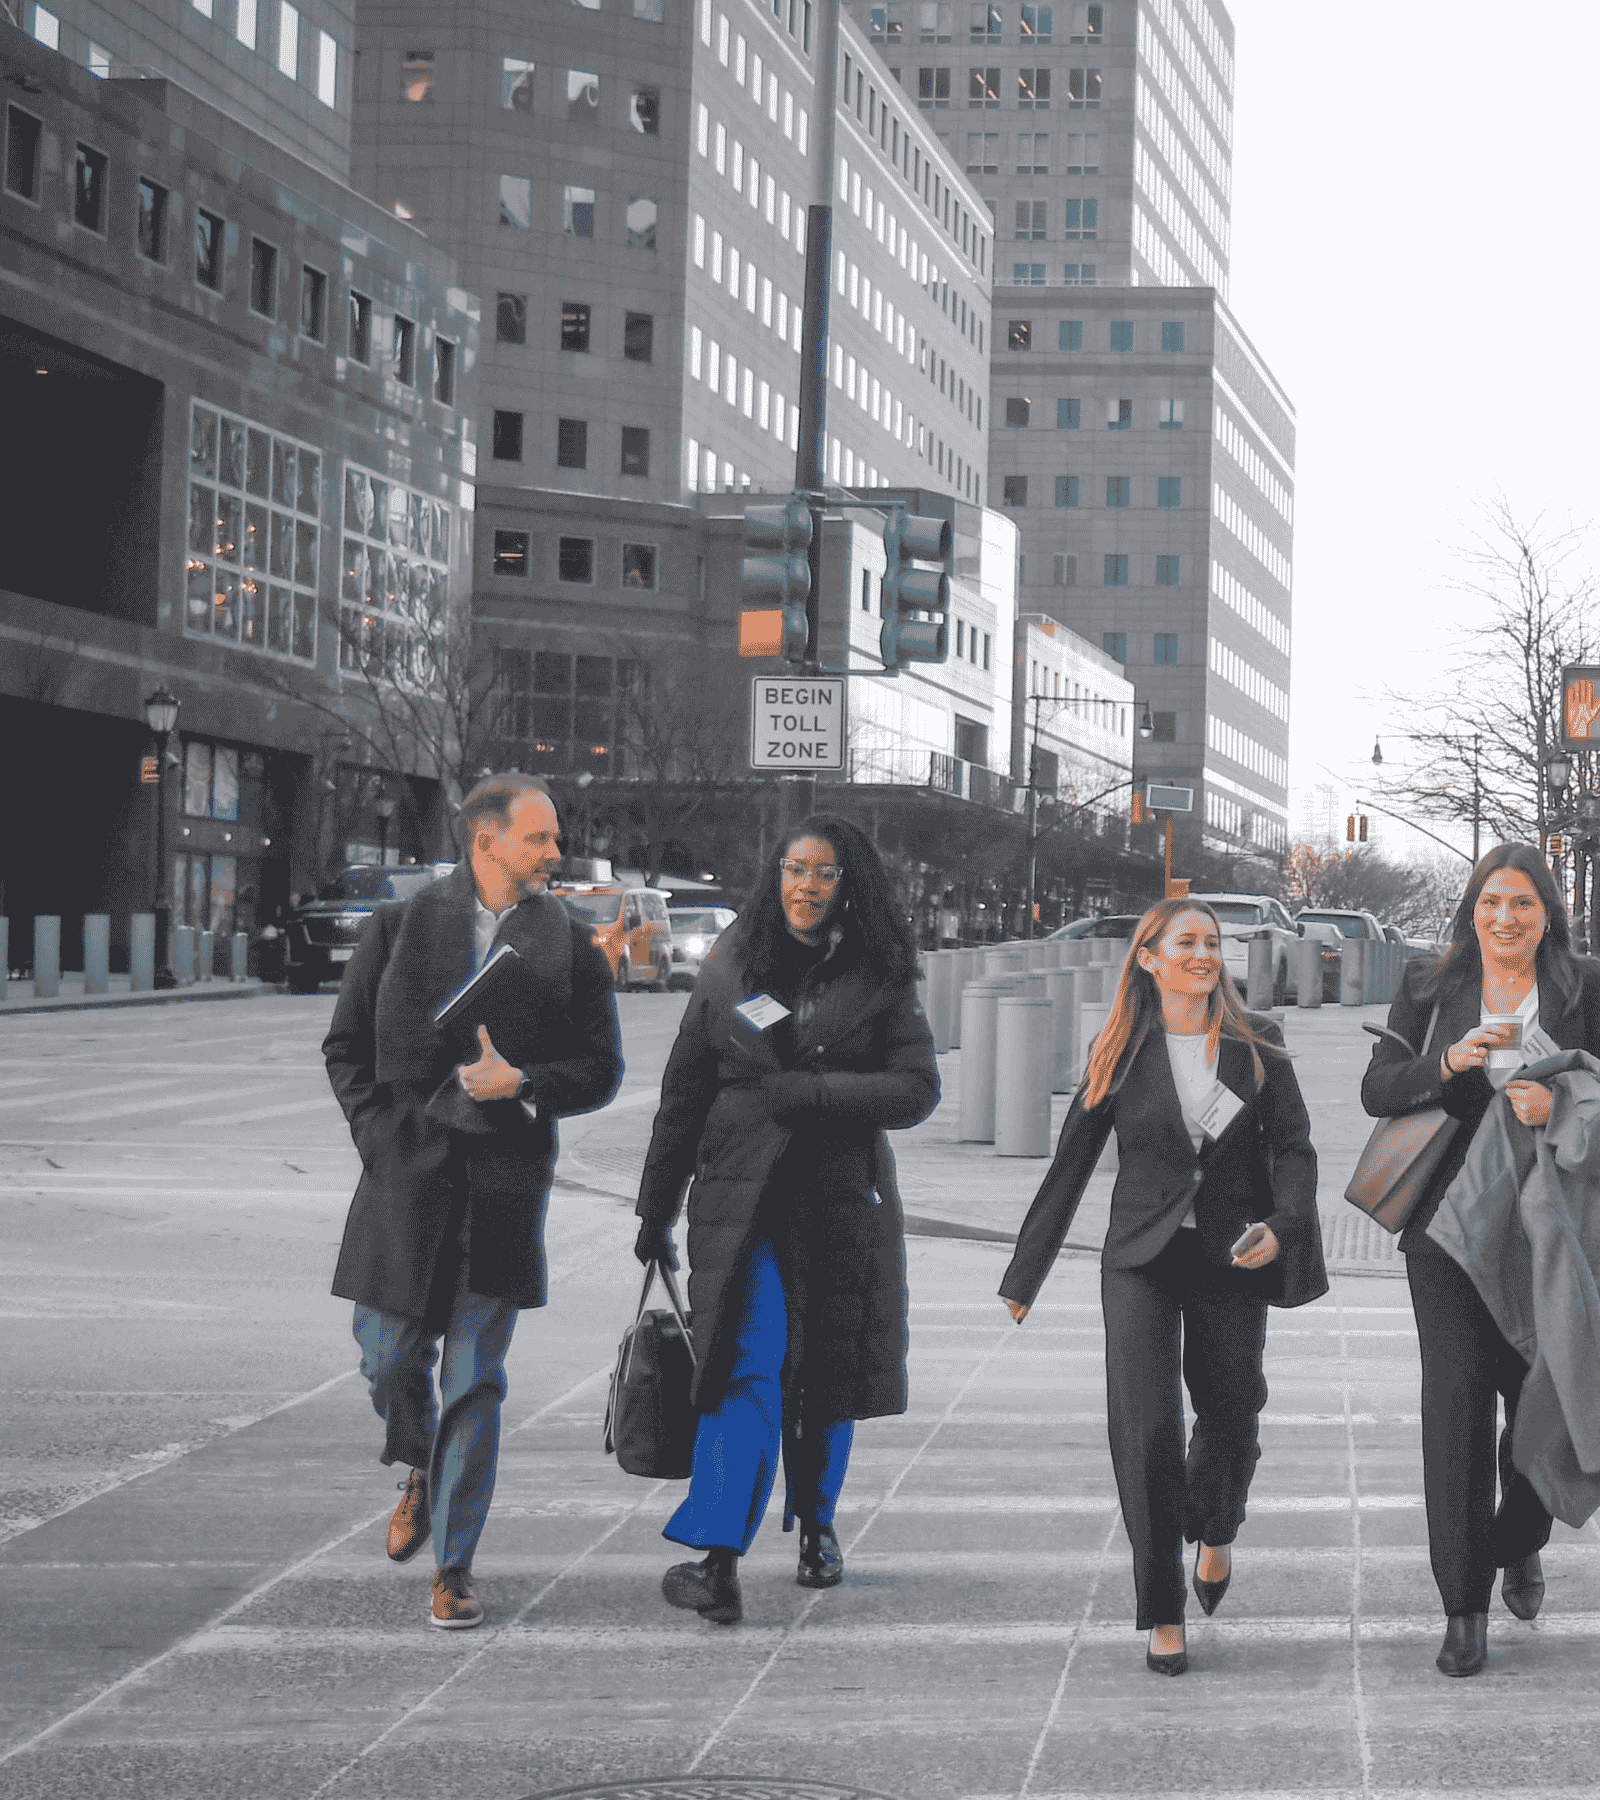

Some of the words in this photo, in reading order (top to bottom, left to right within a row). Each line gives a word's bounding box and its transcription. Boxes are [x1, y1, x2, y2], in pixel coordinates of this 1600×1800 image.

[765, 687, 833, 706] BEGIN
[769, 714, 827, 732] TOLL
[766, 741, 829, 759] ZONE
